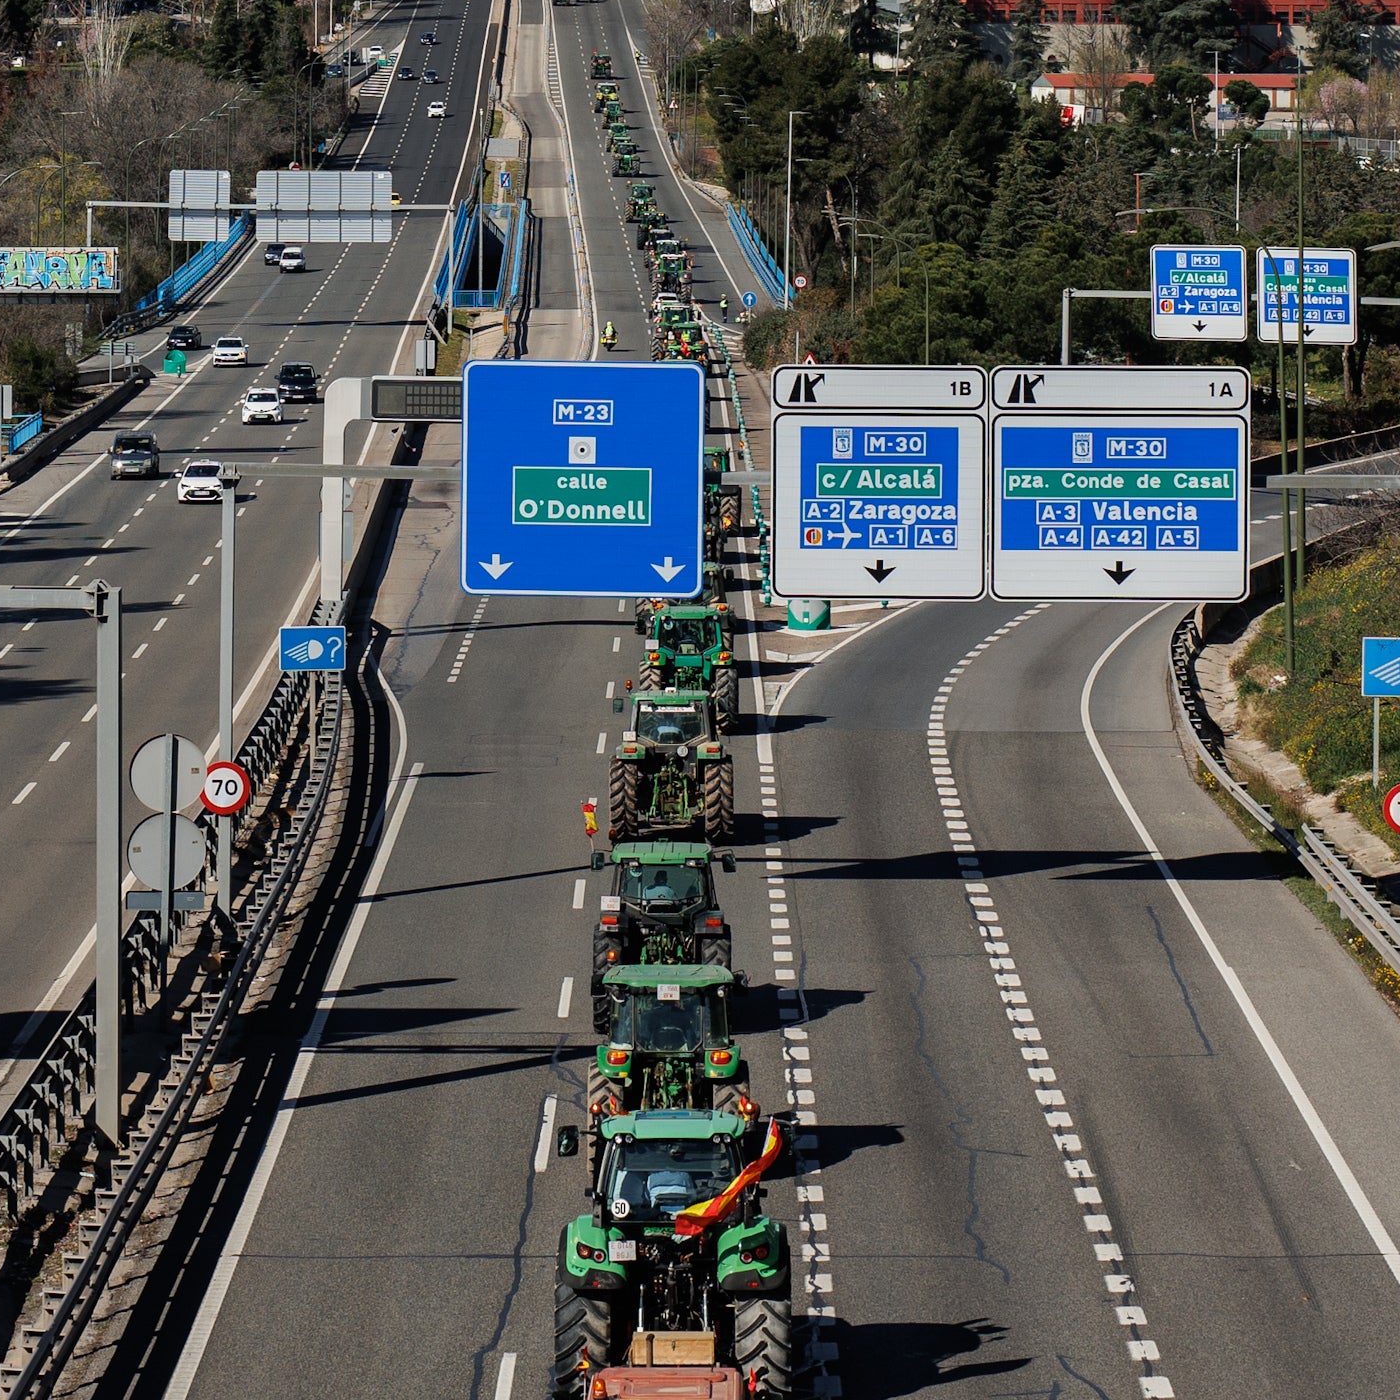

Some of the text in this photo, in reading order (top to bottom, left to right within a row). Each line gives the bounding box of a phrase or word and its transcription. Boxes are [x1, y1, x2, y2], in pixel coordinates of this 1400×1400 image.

[1193, 256, 1218, 265] M-30
[1161, 286, 1237, 299] A-2 Zaragoza
[1318, 284, 1346, 293] Casal
[1201, 303, 1239, 312] A-1 A-6
[1326, 312, 1343, 320] A-5
[558, 404, 609, 421] M-23
[869, 436, 922, 452] M-30
[1110, 440, 1163, 456] M-30
[557, 473, 607, 490] calle
[1009, 472, 1230, 491] pza. Conde de Casal
[807, 501, 957, 525] A-2 Zaragoza
[1041, 501, 1198, 521] A-3 Valencia
[874, 529, 954, 545] A-1 A-6
[1044, 529, 1195, 546] A-4 A-42 A-5
[211, 779, 238, 796] 70
[614, 1202, 626, 1215] 50
